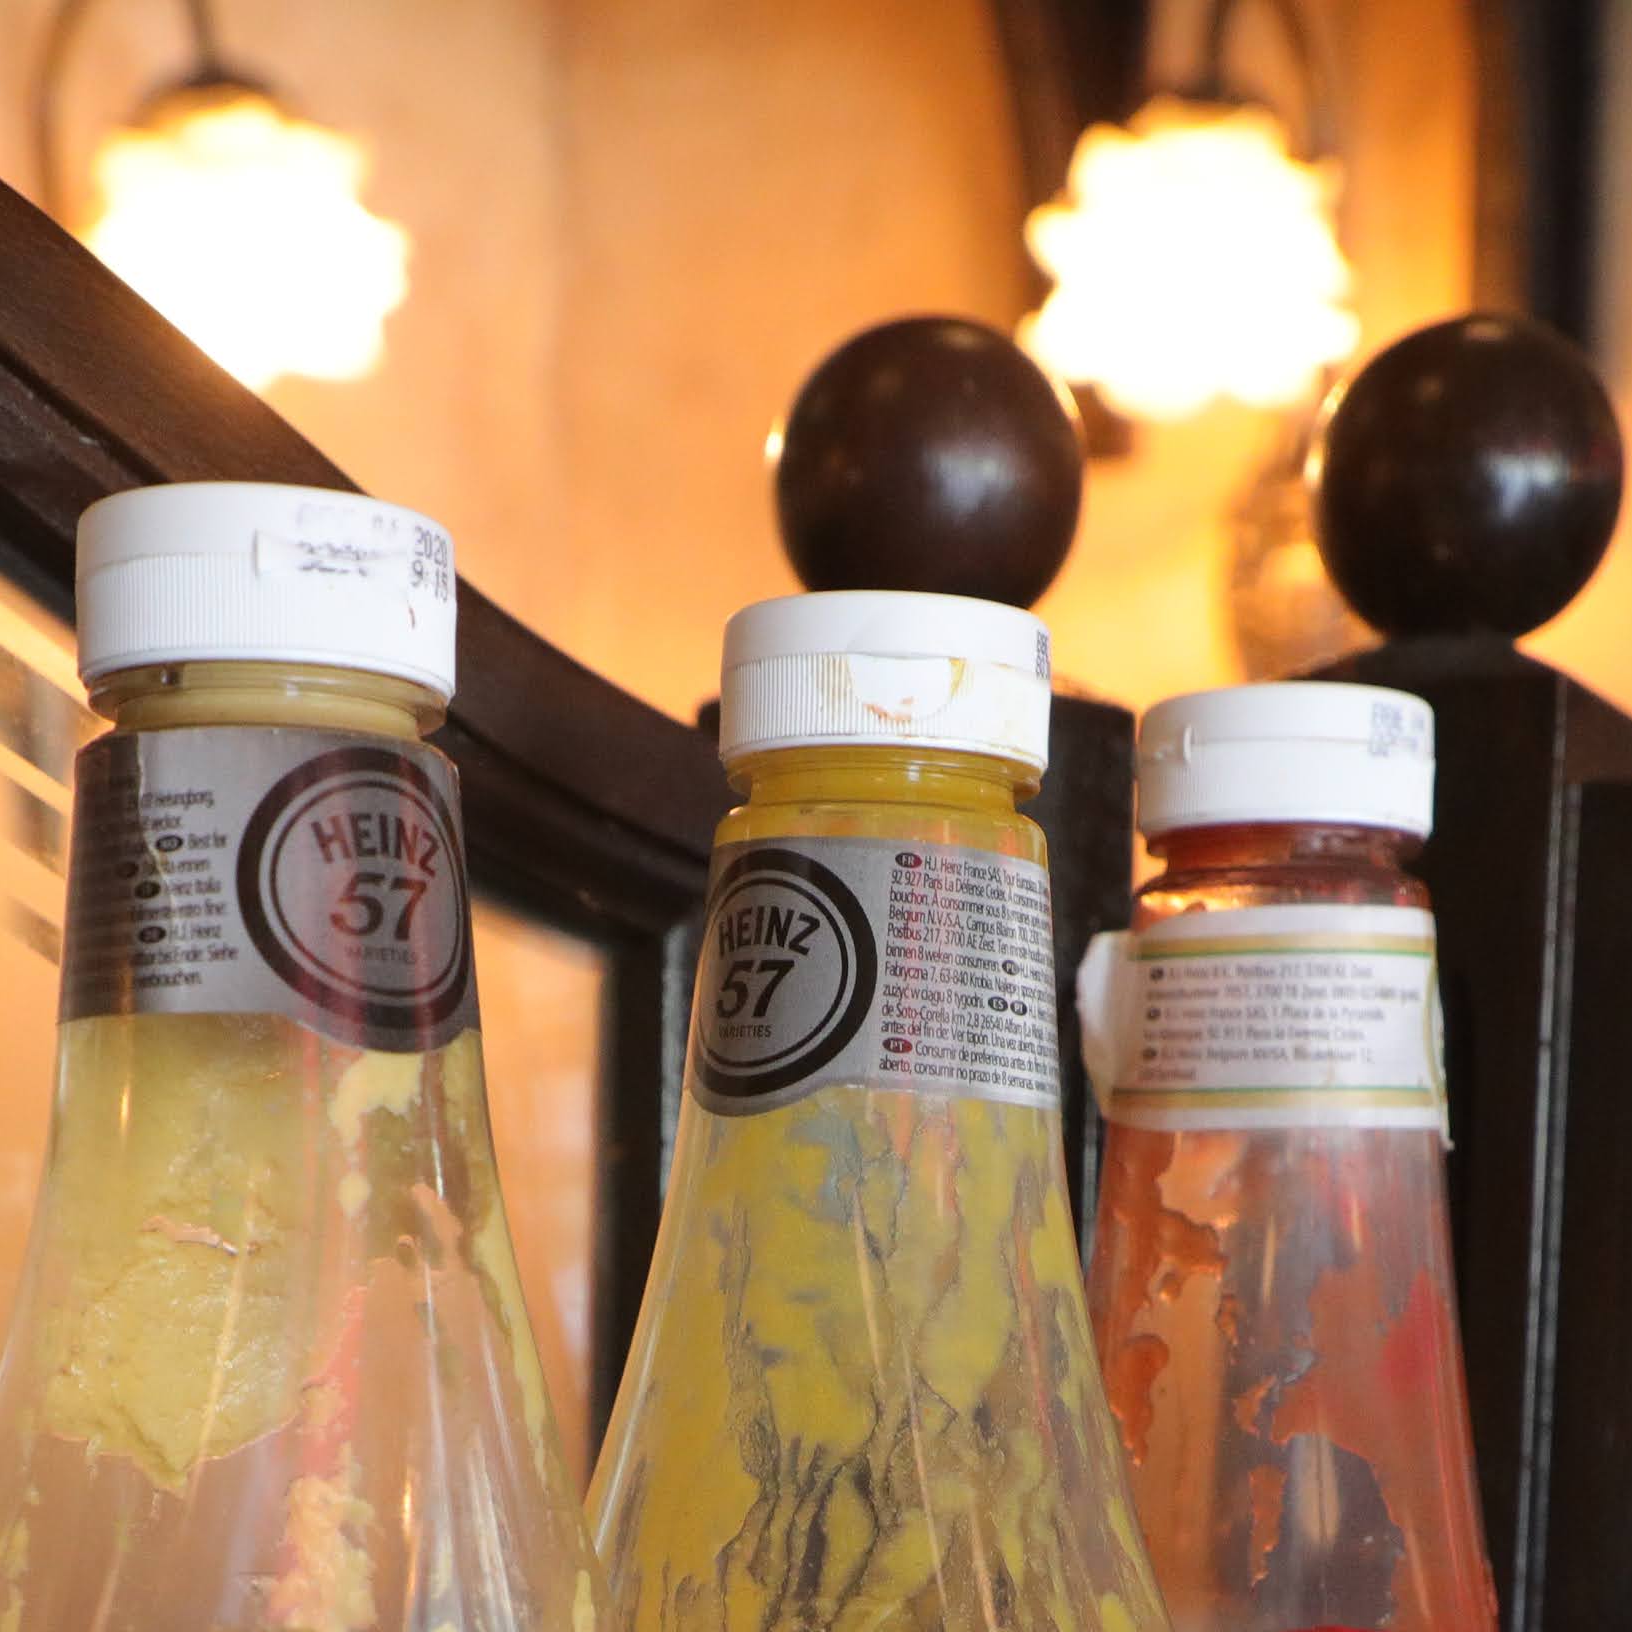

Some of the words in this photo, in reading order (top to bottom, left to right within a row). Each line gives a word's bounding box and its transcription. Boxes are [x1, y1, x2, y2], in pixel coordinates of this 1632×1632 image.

[311, 812, 439, 878] HEINZ
[329, 871, 428, 941] 57
[719, 905, 820, 960] HEINZ
[717, 960, 795, 1019] 57
[719, 1024, 773, 1040] VARIETIES
